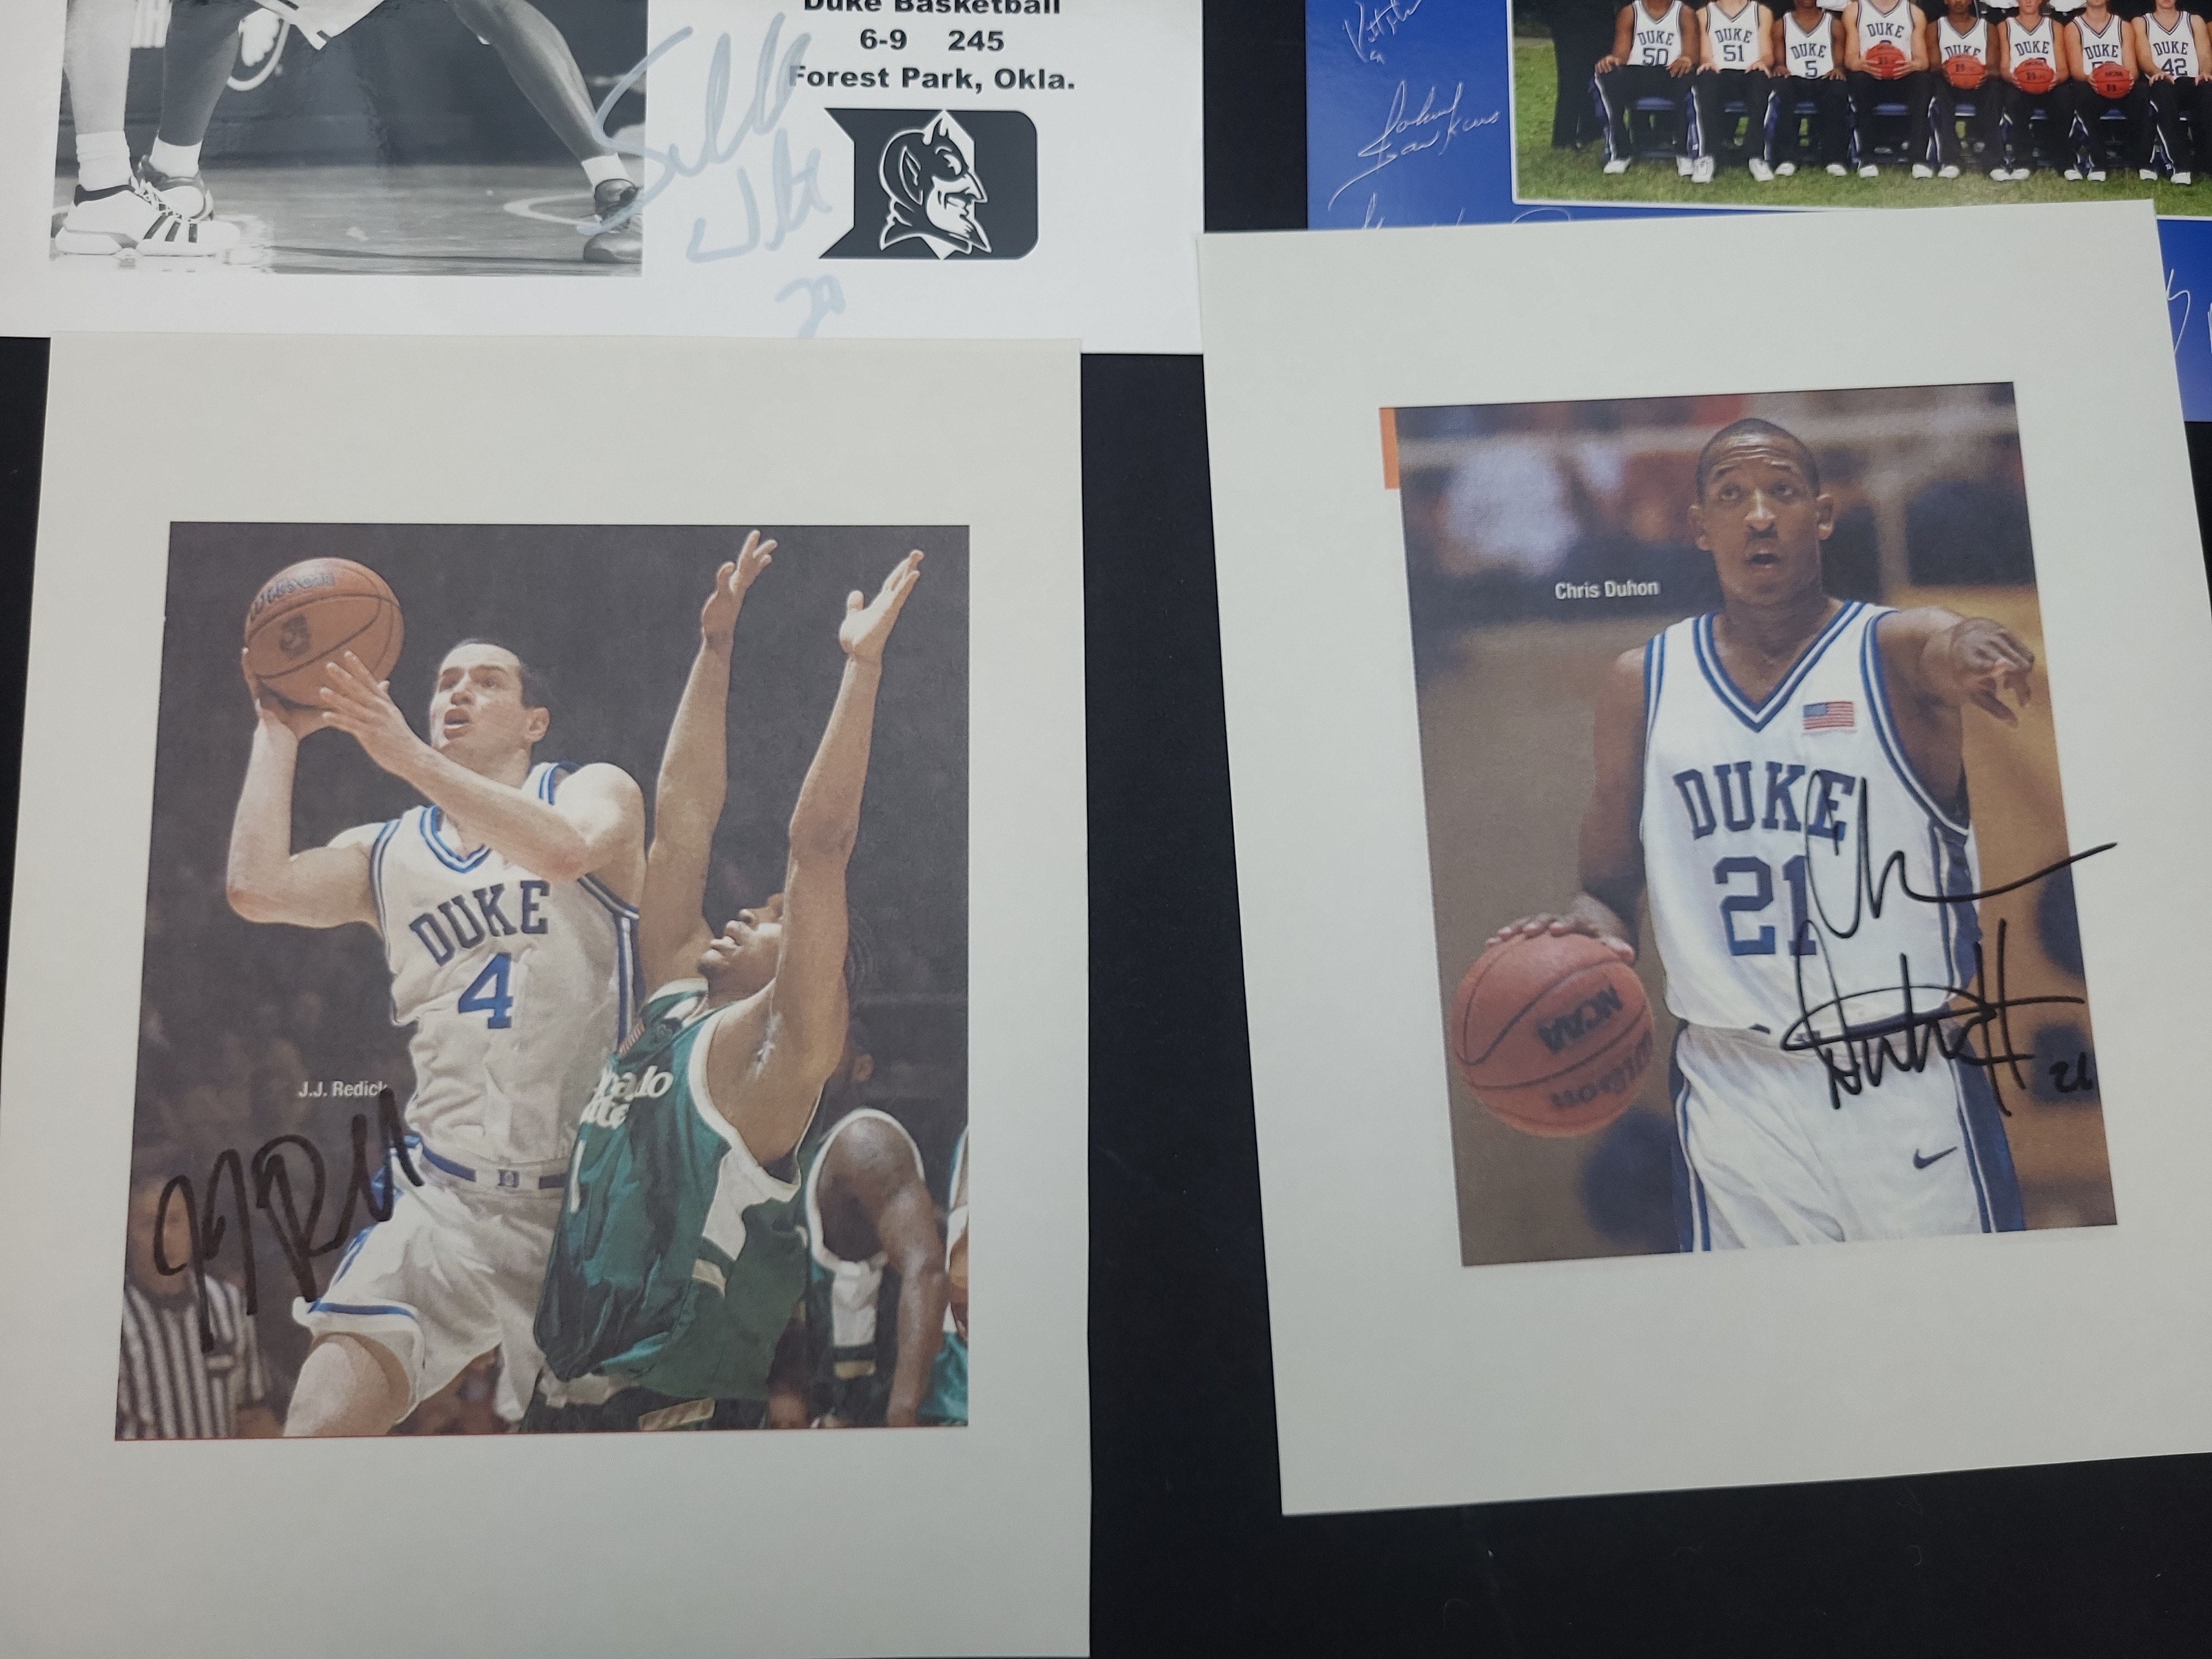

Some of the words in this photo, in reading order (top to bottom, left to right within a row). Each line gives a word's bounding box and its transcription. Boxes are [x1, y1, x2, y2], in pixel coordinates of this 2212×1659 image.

[804, 0, 881, 12] Duke
[895, 0, 1061, 14] Basketball
[1637, 29, 1674, 46] DUKE
[1715, 28, 1752, 44] DUKE
[1866, 22, 1905, 38] DUKE
[860, 28, 907, 51] 6-9
[947, 30, 1005, 52] 245
[2015, 40, 2050, 56] DUKE
[2152, 40, 2189, 56] DUKE
[1642, 48, 1669, 66] 50
[1723, 45, 1745, 62] 51
[1790, 43, 1827, 59] DUKE
[1944, 44, 1981, 58] DUKE
[2084, 44, 2119, 60] DUKE
[1804, 60, 1818, 77] 5
[2161, 58, 2188, 76] 42
[789, 65, 890, 88] Forest
[902, 67, 983, 93] Park,
[994, 68, 1075, 90] Okla.
[1555, 581, 1601, 600] Chris
[1604, 579, 1659, 598] Duhon
[1672, 760, 1855, 842] DUKE
[1713, 854, 1817, 957] 21
[409, 879, 551, 967] DUKE
[457, 952, 515, 1030] 4
[298, 1081, 328, 1098] J.J.
